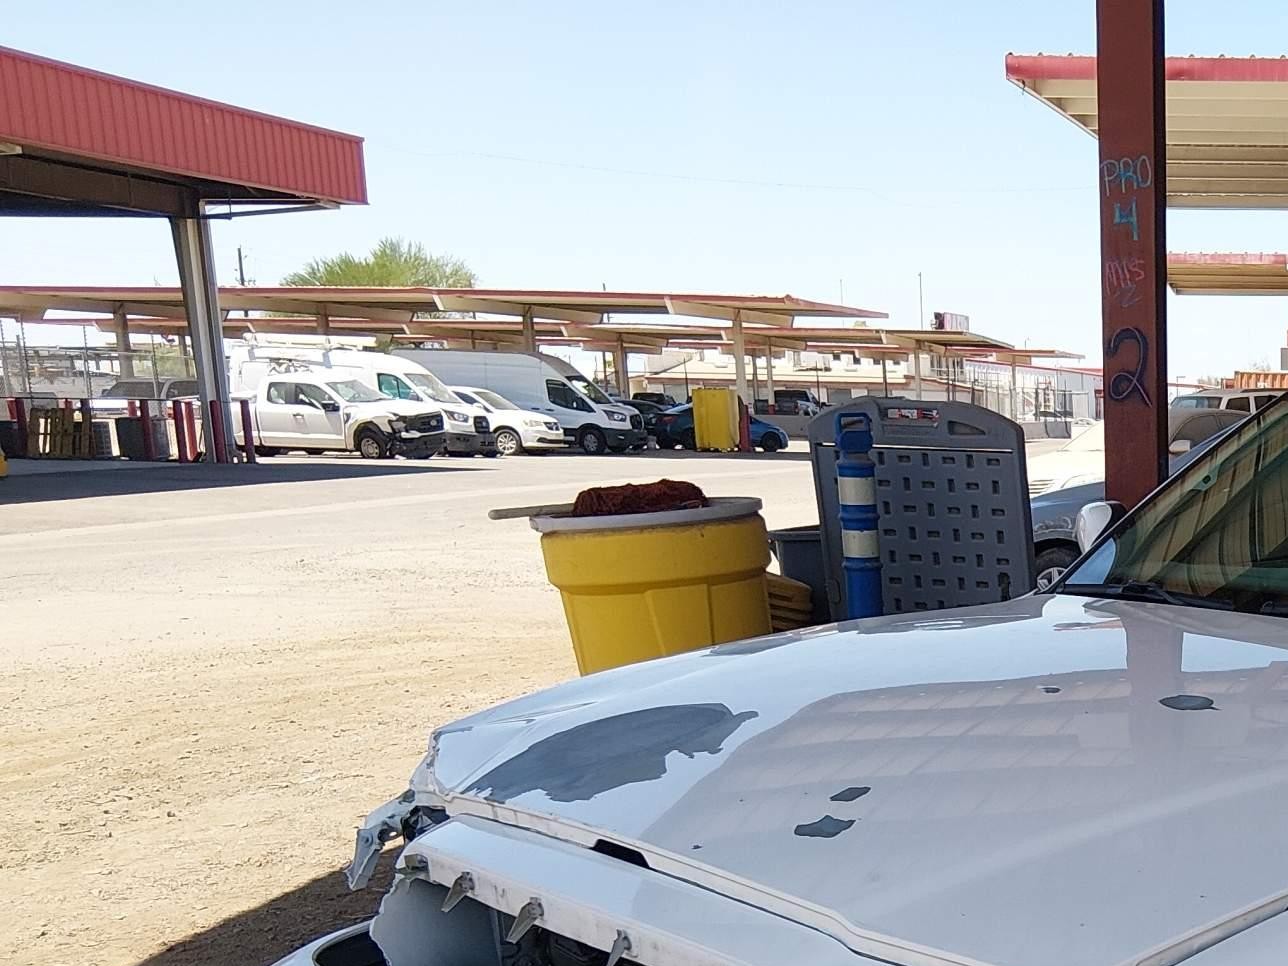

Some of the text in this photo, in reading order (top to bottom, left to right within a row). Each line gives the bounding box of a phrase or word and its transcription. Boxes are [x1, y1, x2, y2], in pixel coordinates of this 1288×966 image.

[1100, 155, 1152, 197] PRO
[1113, 197, 1140, 241] 4
[1106, 326, 1152, 408] 2
